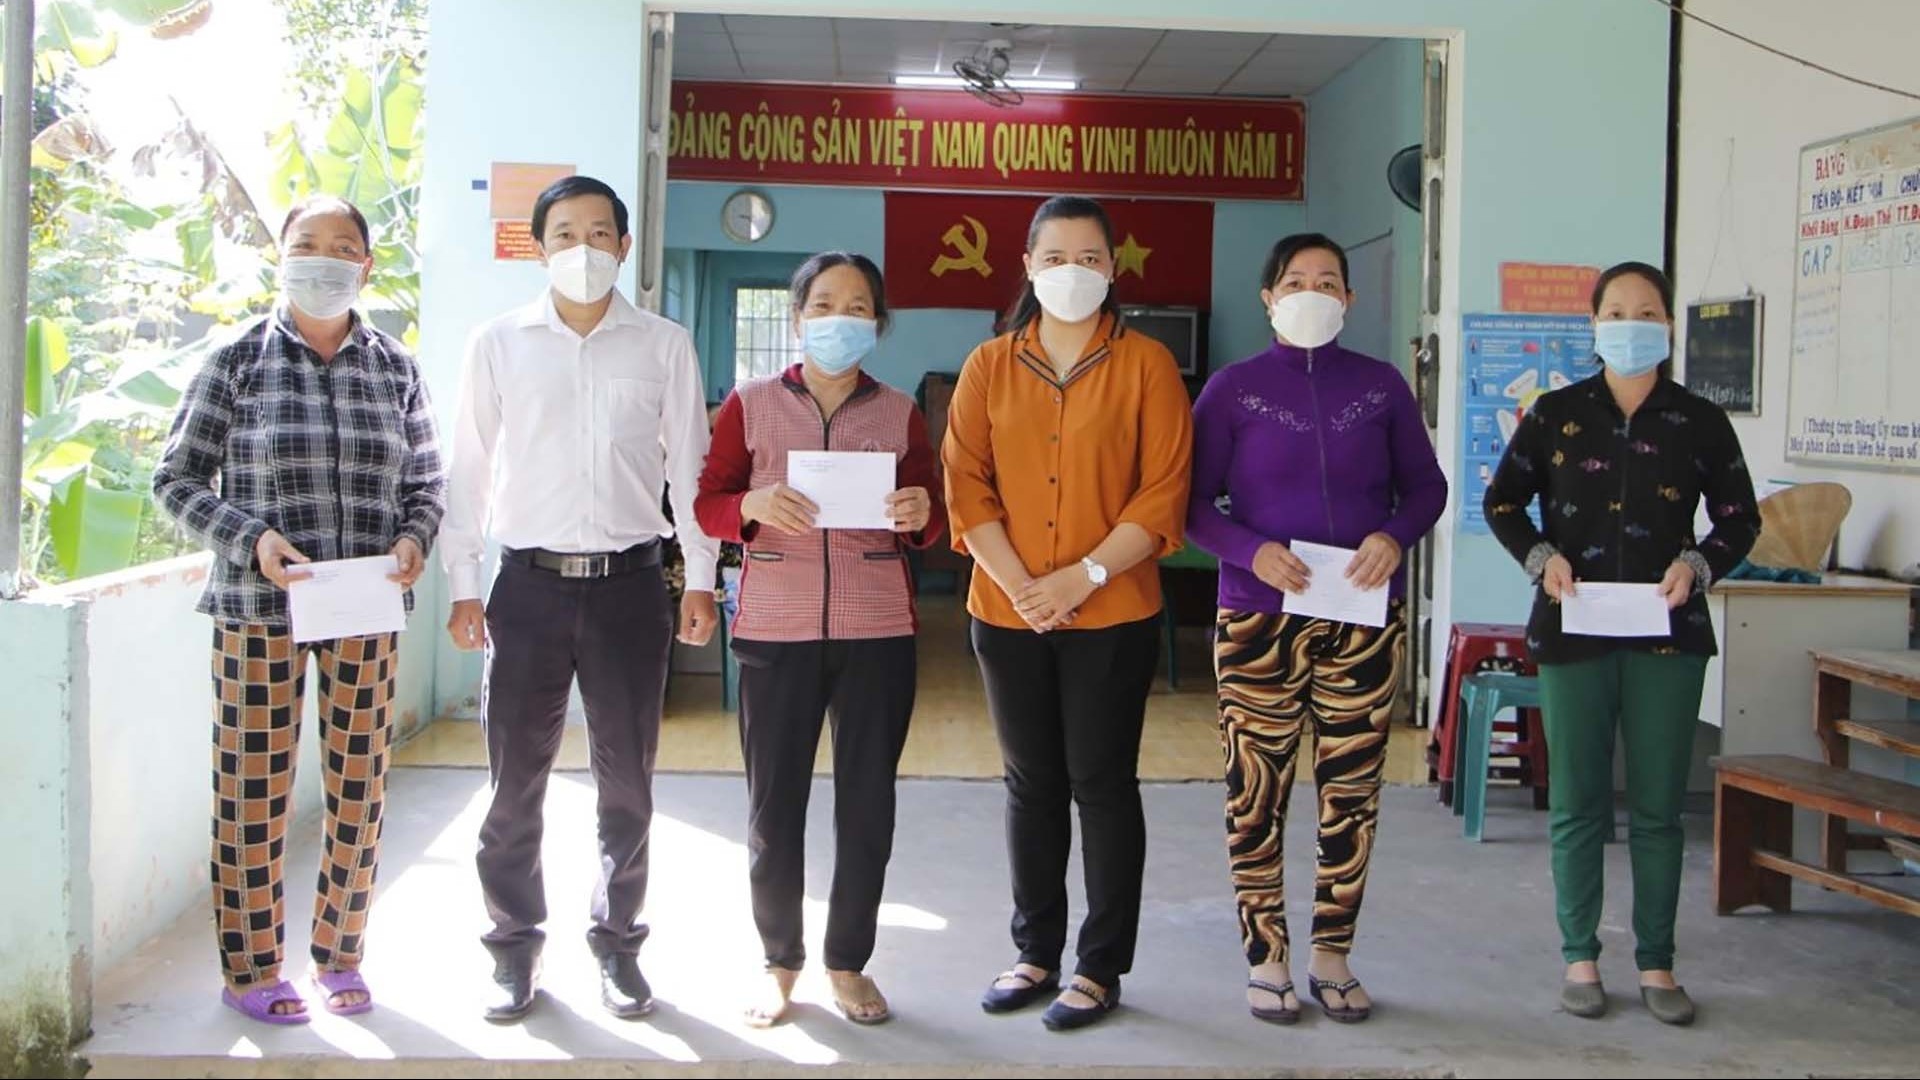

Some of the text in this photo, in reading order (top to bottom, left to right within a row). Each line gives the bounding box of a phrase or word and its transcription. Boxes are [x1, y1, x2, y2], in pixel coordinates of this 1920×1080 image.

[738, 101, 805, 171] CỘNG
[811, 98, 861, 166] SẢN
[868, 106, 924, 177] VIỆT
[931, 120, 986, 169] NAM
[993, 122, 1073, 180] QUANG
[1080, 125, 1137, 174] VINH
[1145, 116, 1216, 177] MUÔN
[1223, 122, 1277, 179] NĂM
